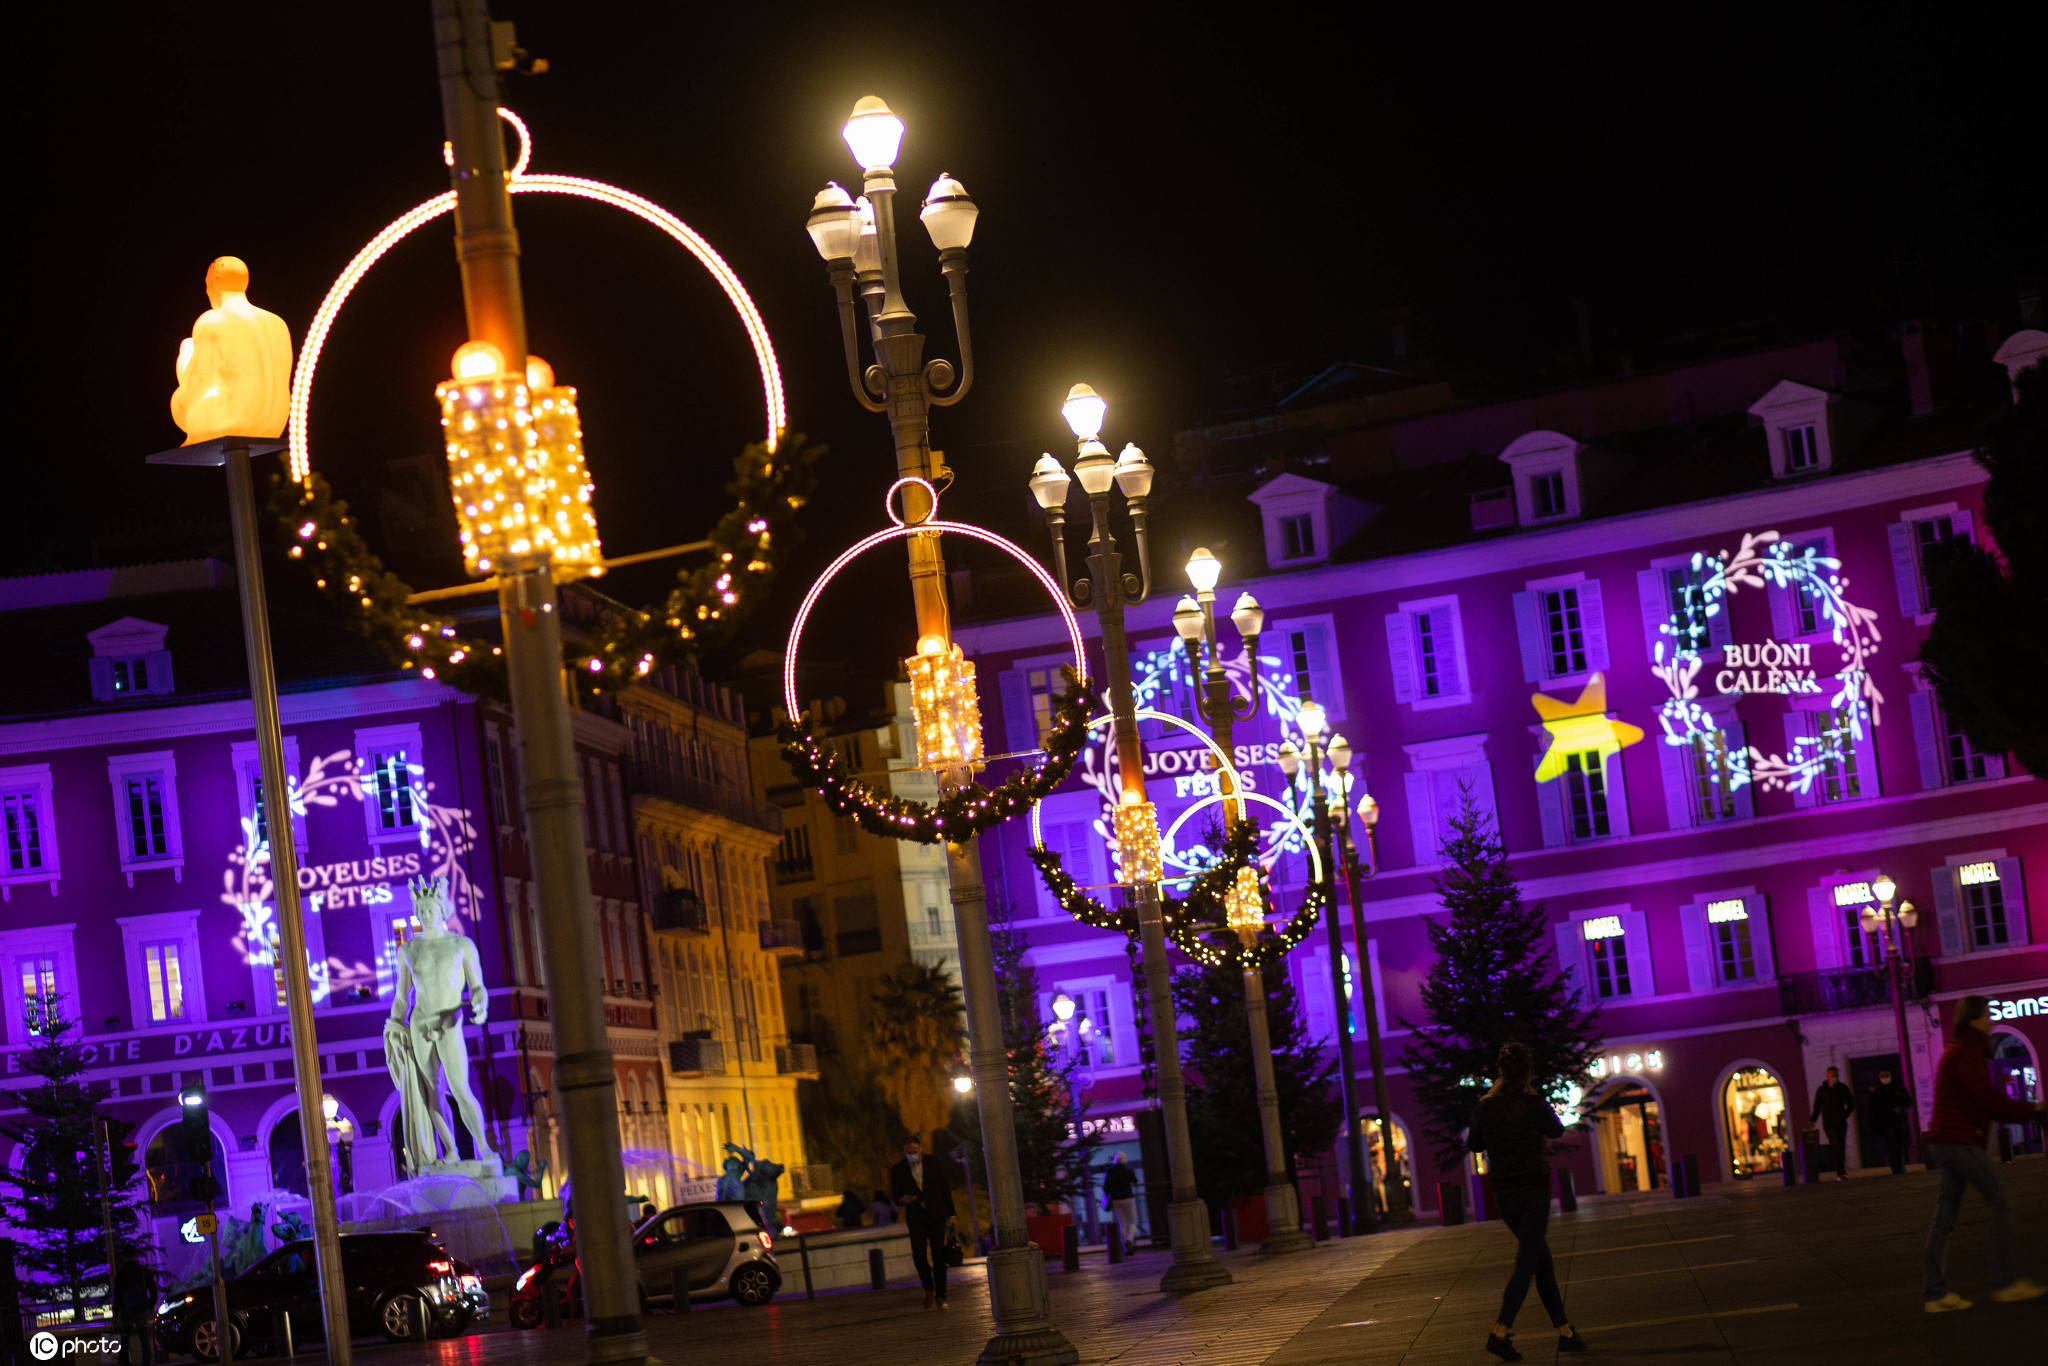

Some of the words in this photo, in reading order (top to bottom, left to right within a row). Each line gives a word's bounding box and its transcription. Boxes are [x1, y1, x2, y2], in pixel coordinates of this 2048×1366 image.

[1142, 743, 1280, 775] JOYESES
[297, 852, 421, 890] OYEUSES
[1960, 861, 2001, 886] HOTEL
[309, 881, 393, 912] FÊTES
[1834, 881, 1875, 907] HOTEL
[1707, 898, 1749, 924] HOTEL
[1583, 915, 1626, 941] HOTEL
[60, 1039, 142, 1067] OTE
